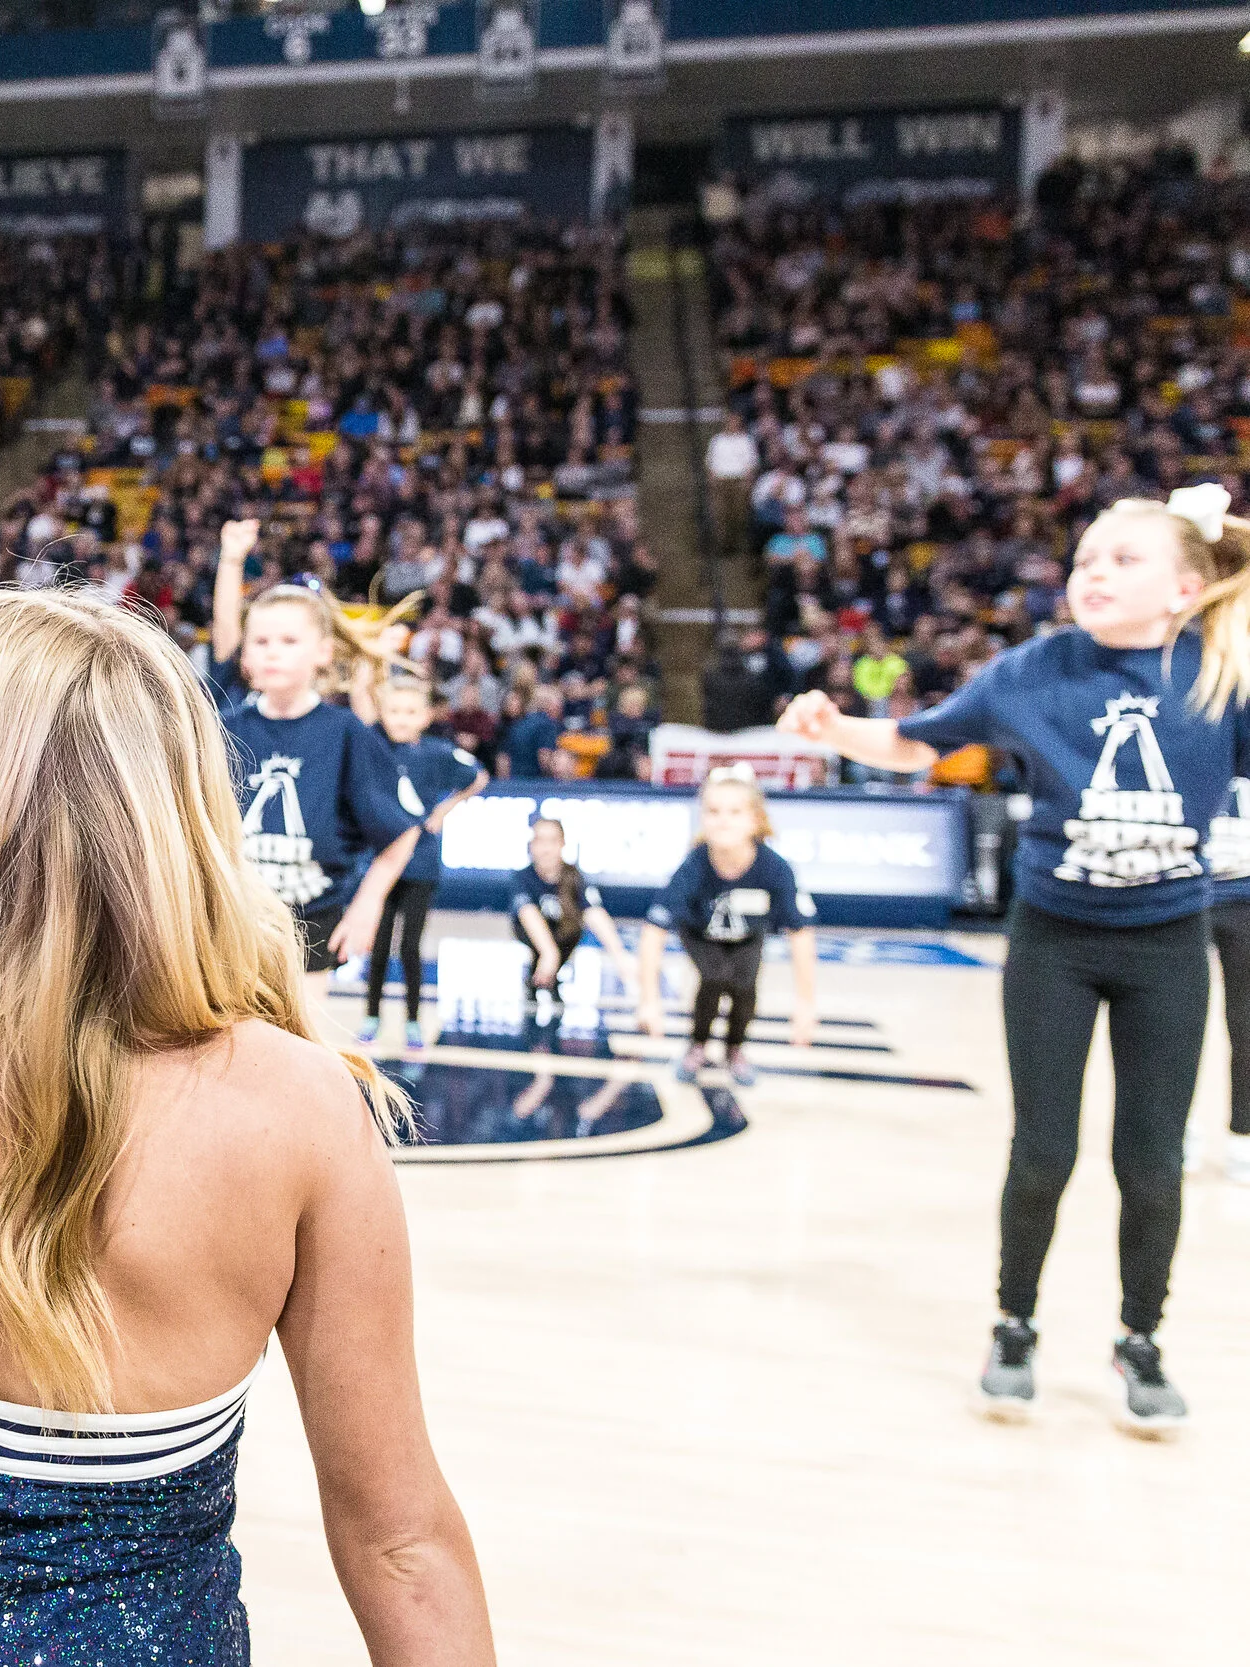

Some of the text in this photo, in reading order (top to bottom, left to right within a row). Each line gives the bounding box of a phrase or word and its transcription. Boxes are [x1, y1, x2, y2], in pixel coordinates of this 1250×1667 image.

[306, 134, 531, 183] THAT WE
[751, 113, 1002, 161] WILL WIN
